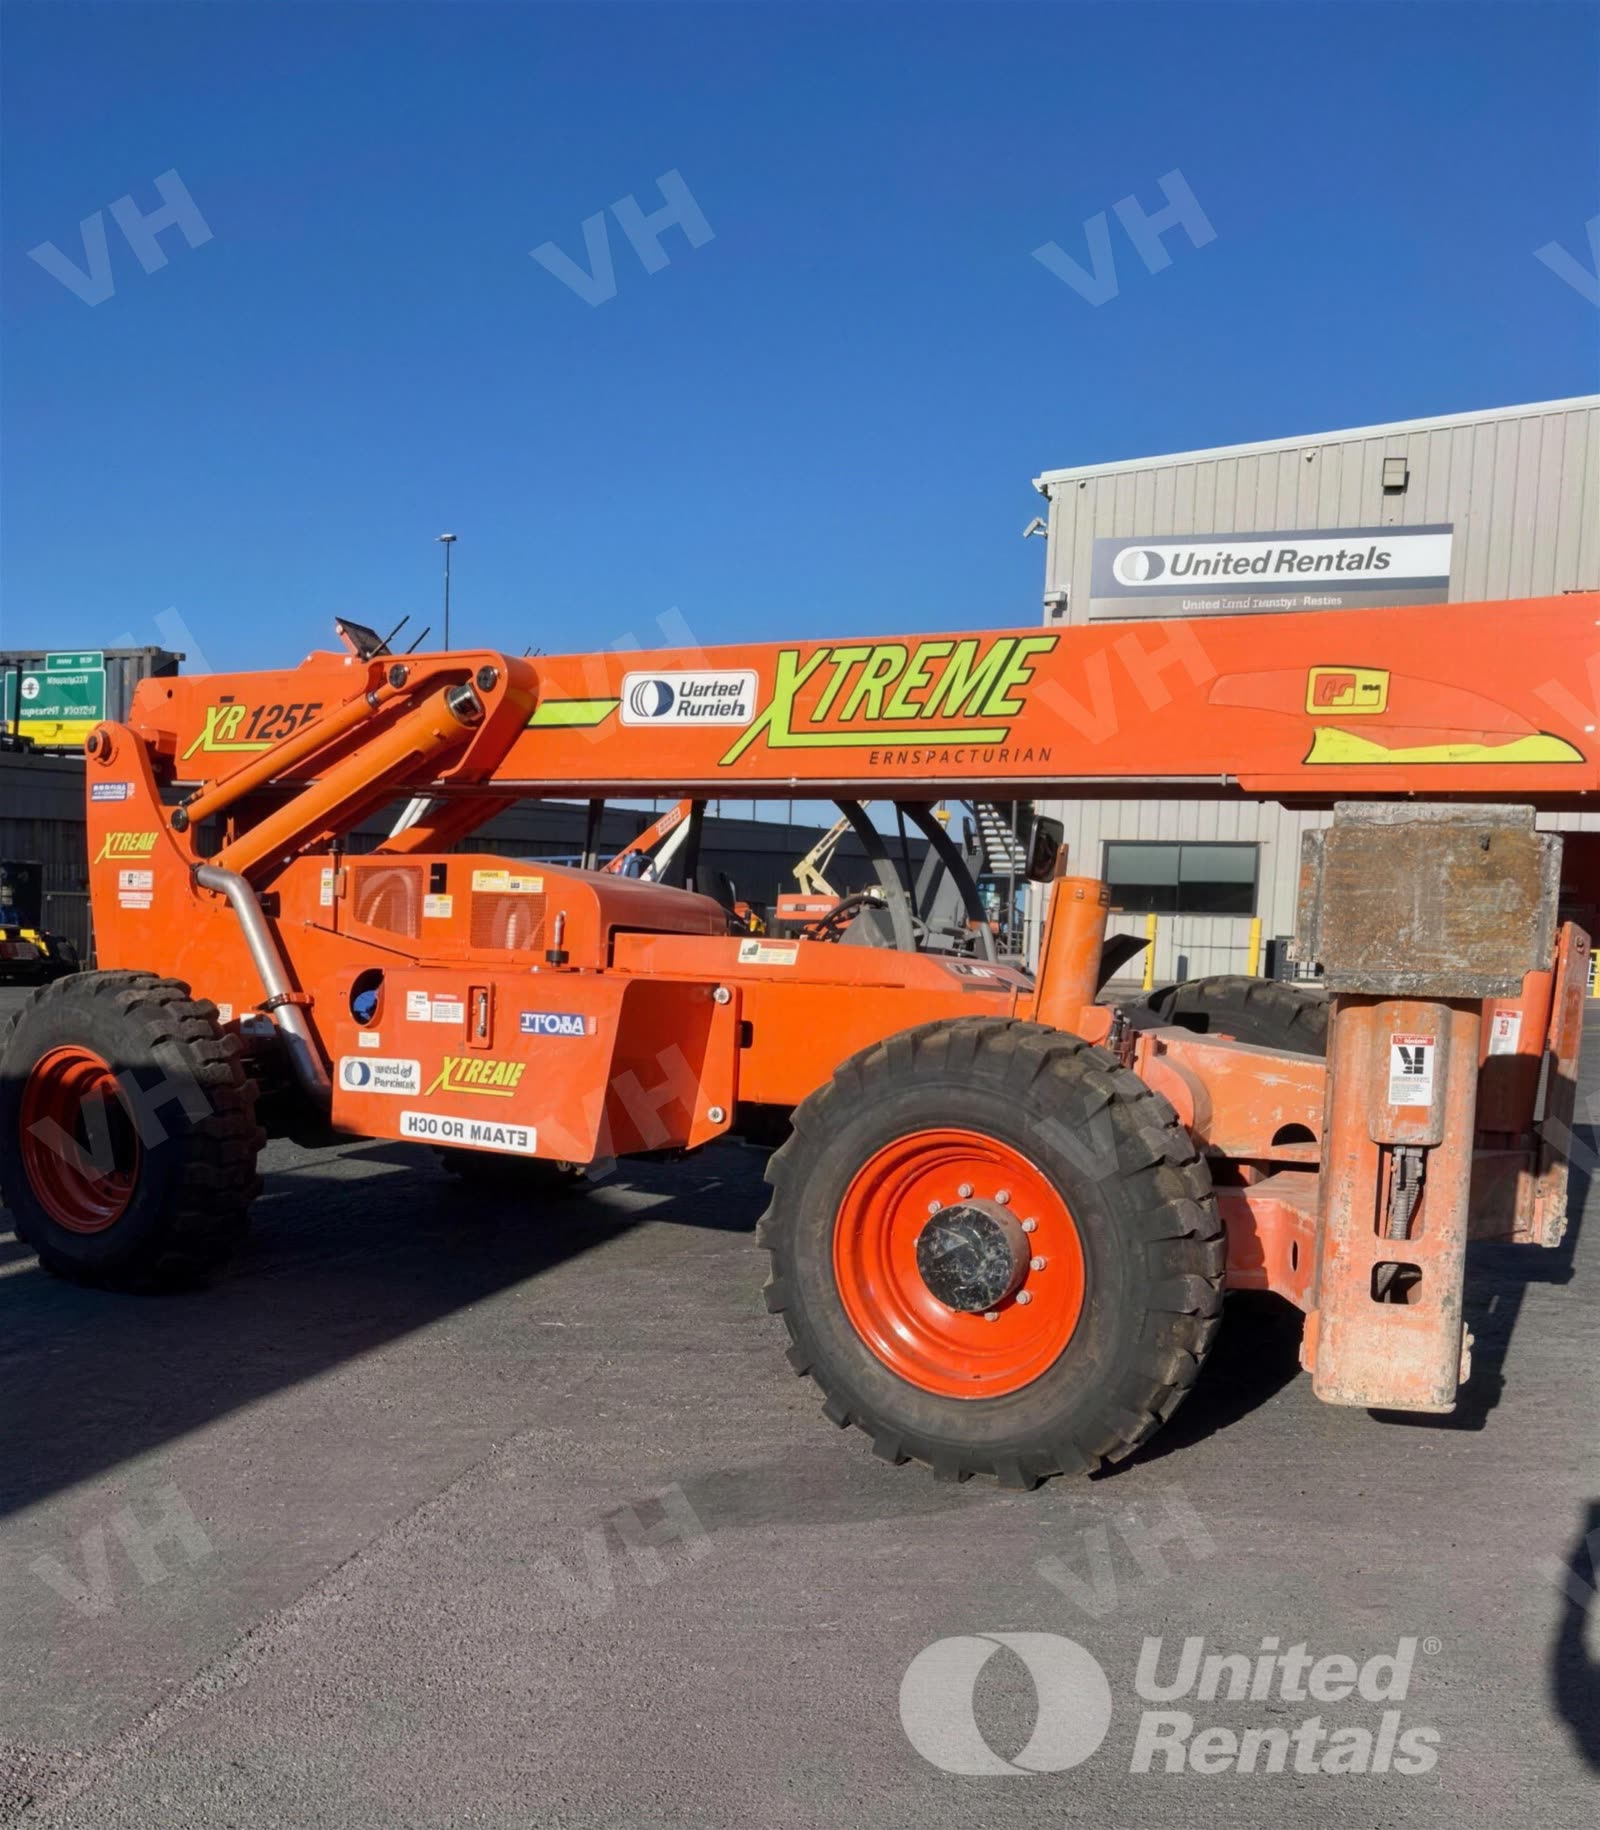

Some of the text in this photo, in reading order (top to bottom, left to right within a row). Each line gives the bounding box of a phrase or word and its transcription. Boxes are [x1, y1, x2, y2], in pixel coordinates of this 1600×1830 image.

[1170, 546, 1391, 577] United Rentals
[718, 635, 1061, 766] XTREME
[181, 705, 247, 761] XR
